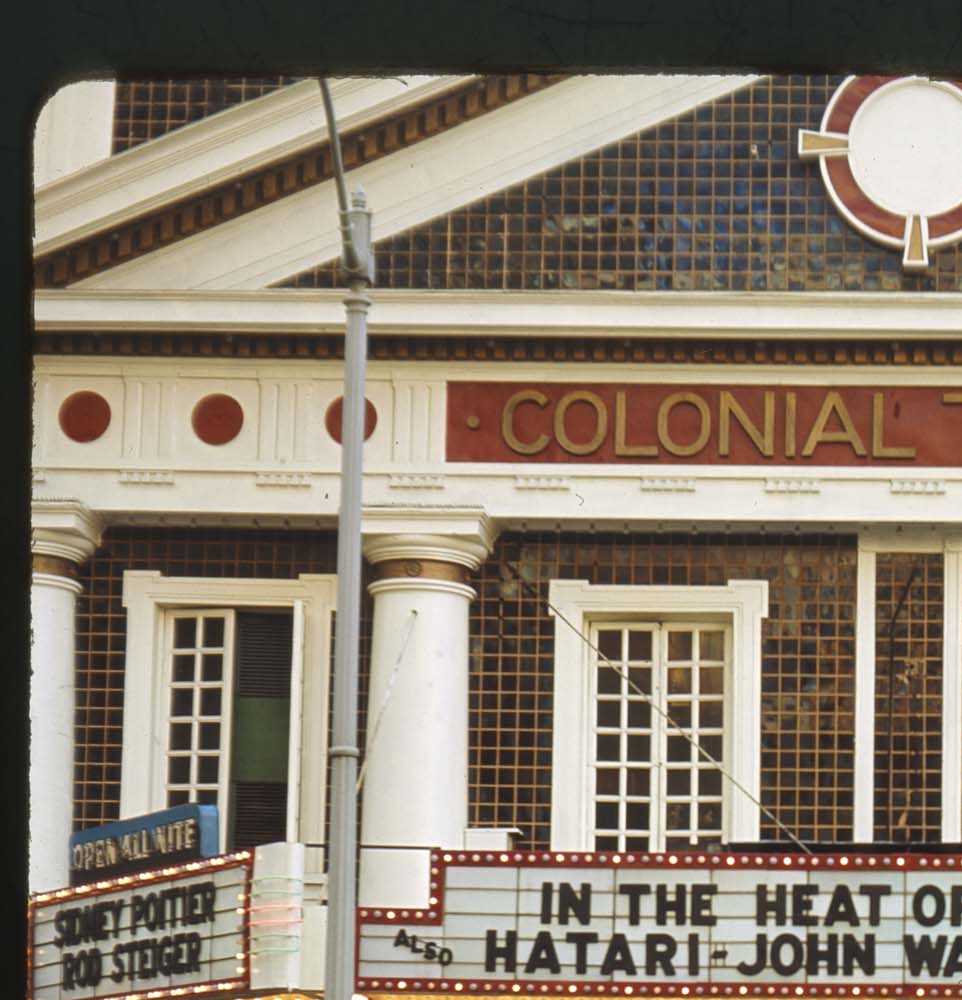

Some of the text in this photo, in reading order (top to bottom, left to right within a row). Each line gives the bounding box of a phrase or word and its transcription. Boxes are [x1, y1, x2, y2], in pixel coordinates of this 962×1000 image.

[501, 389, 917, 459] COLONIAL
[73, 818, 196, 870] OPEN ALL NITE
[54, 899, 124, 949] SIDNEY
[541, 882, 592, 926] IN
[619, 884, 718, 928] THE
[756, 884, 892, 928] HEAT
[63, 932, 202, 992] ROD STEIGER
[392, 927, 454, 967] ALSO
